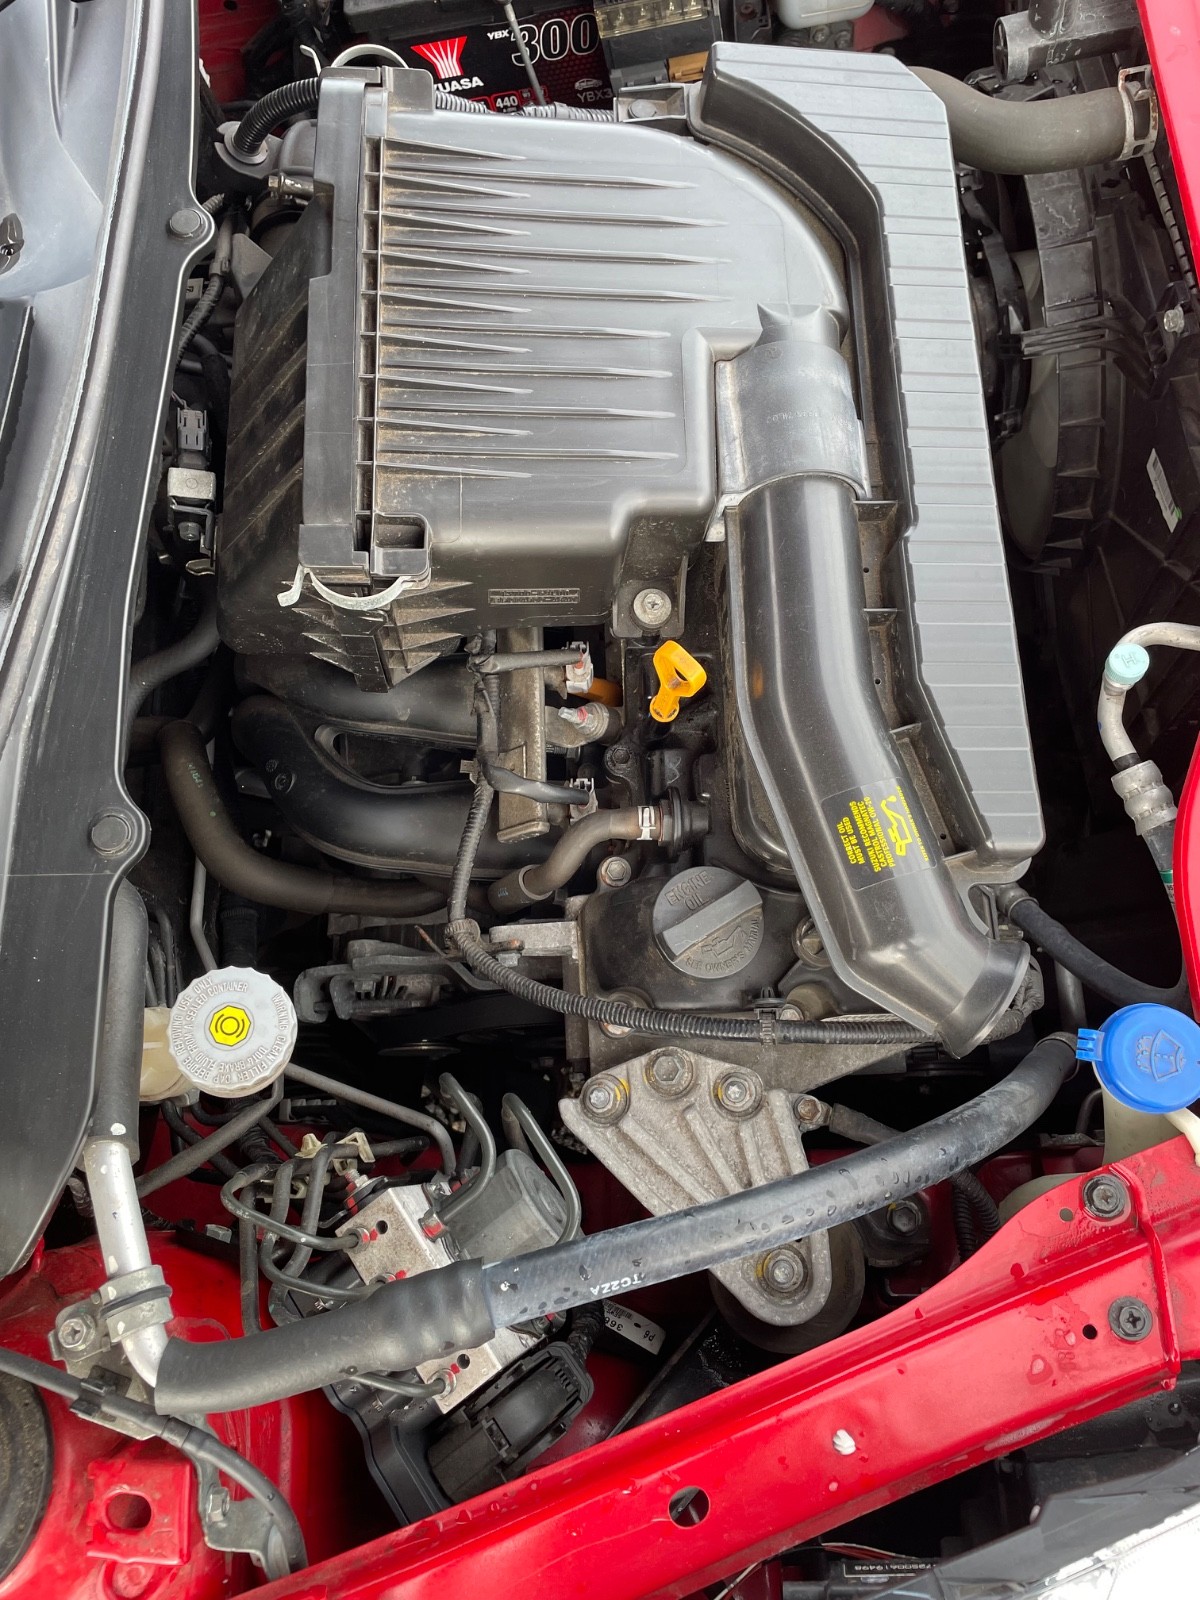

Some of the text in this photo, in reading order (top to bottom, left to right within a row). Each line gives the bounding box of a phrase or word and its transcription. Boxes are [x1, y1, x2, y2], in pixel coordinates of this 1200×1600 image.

[486, 13, 599, 67] YBX 300
[496, 95, 518, 108] 440
[836, 821, 857, 864] CORRECT OIL
[842, 816, 865, 864] MUST BE USED
[849, 801, 881, 872] SUZUKI RECOMMENDS
[857, 800, 887, 867] CASTROL MAGNATEC
[873, 818, 896, 867] PROFESSIONAL
[664, 870, 711, 911] ENGINE OIL
[185, 993, 208, 1021] SEALED
[207, 981, 248, 997] CONTAINER
[171, 976, 289, 1084] WARNING CLEAN FILLER CAP BEFORE REMOVING USE ONLY
[184, 1032, 198, 1053] FROM
[196, 1052, 217, 1070] FLUID
[220, 1061, 246, 1072] BRAKE
